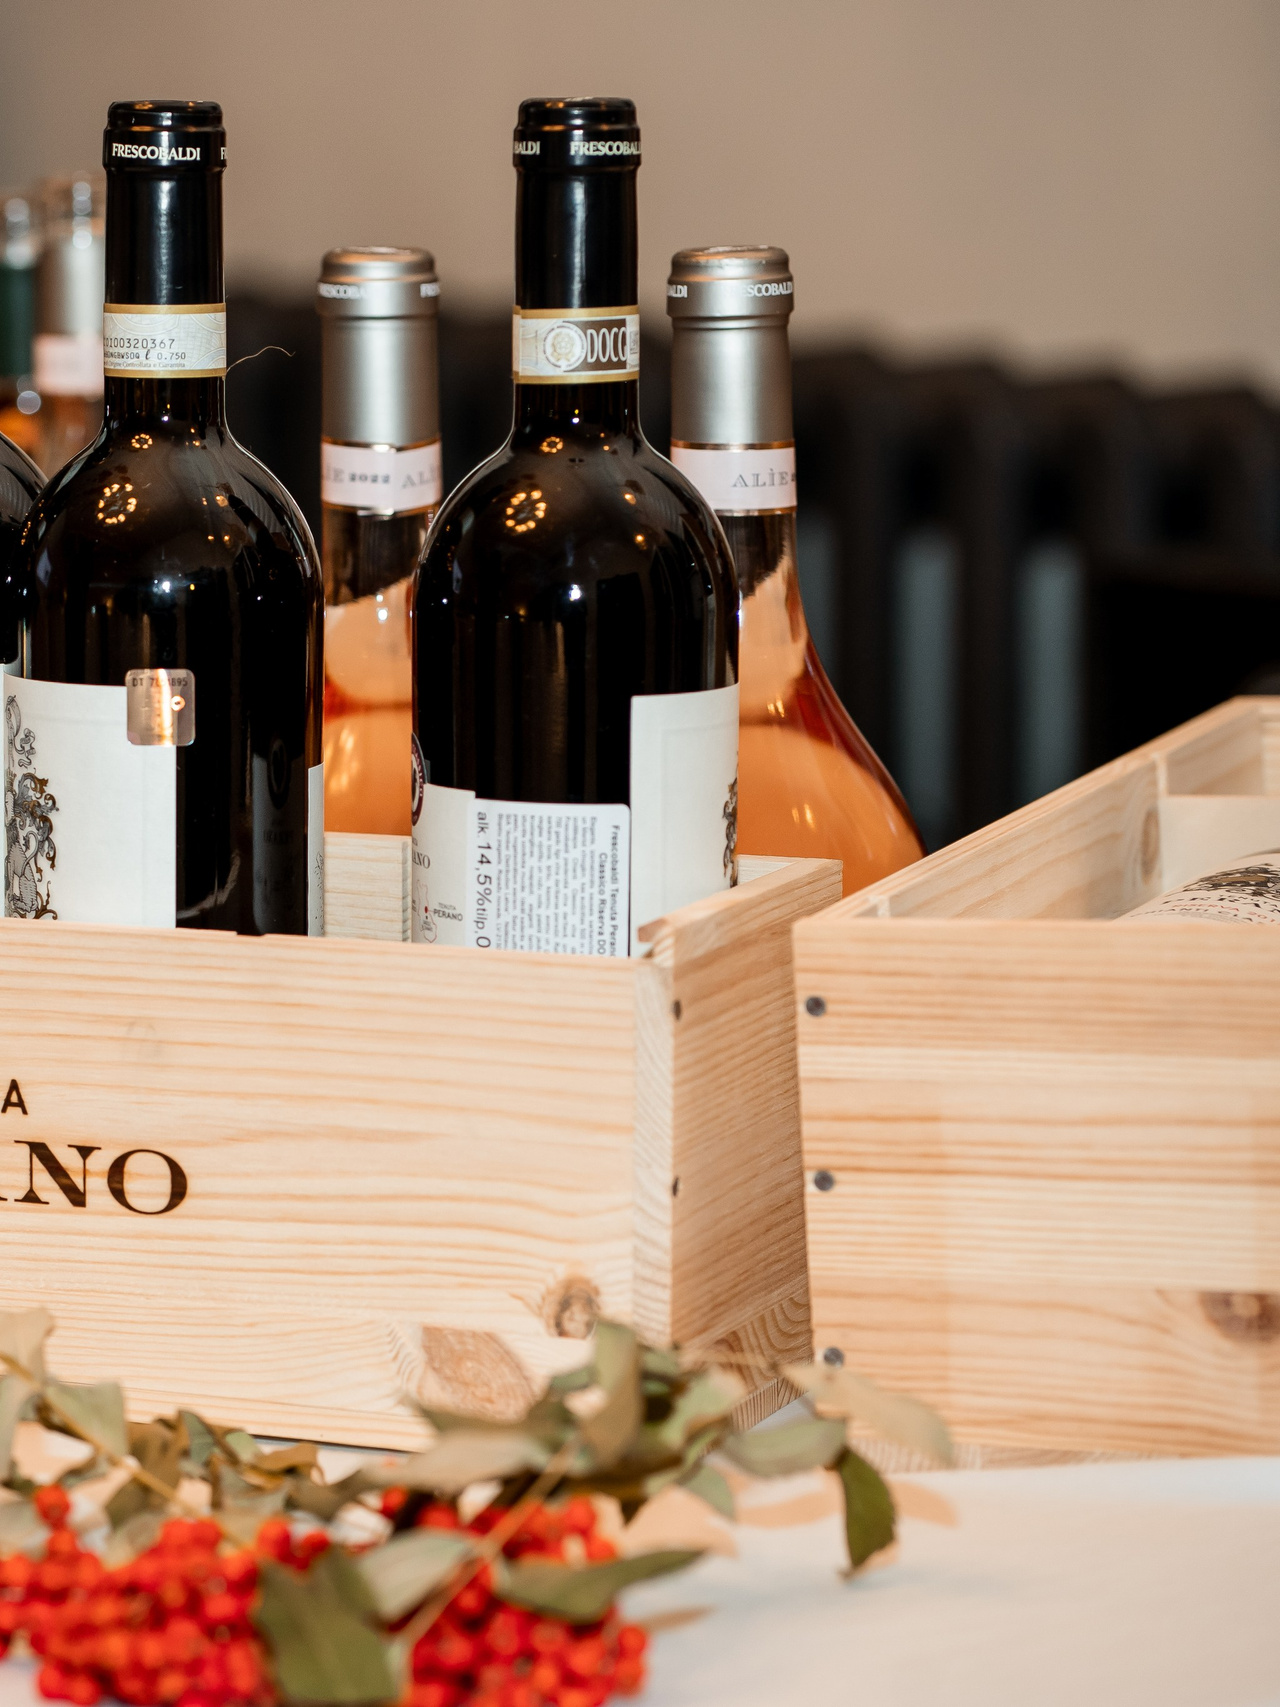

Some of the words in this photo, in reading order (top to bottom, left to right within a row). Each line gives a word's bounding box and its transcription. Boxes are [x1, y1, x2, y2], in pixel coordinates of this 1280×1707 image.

[112, 143, 201, 160] FRESCOBALDI
[157, 352, 186, 360] 0.750
[132, 678, 144, 687] DT
[476, 811, 490, 839] alk.
[610, 825, 620, 885] Frescobaldi
[598, 852, 608, 896] Classico
[433, 908, 463, 922] PERANO
[597, 899, 607, 936] Riserva
[609, 888, 619, 921] Tenuta
